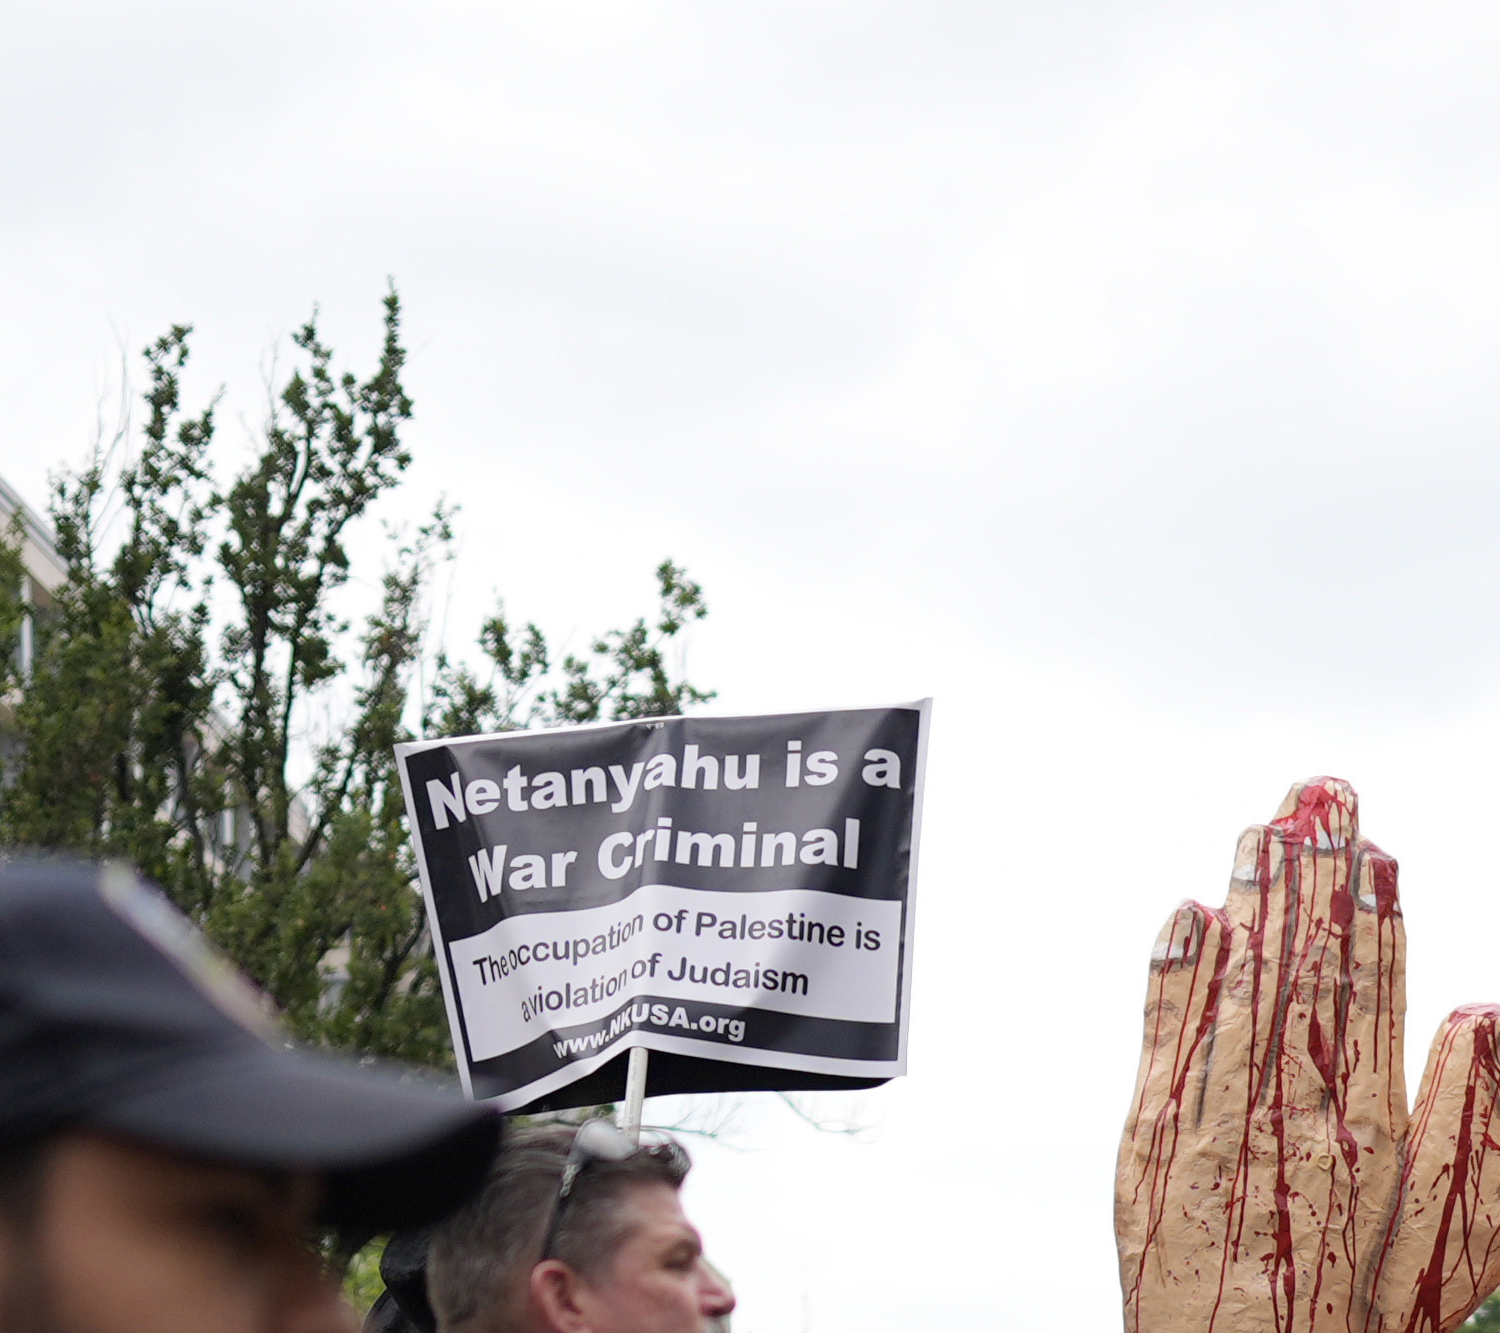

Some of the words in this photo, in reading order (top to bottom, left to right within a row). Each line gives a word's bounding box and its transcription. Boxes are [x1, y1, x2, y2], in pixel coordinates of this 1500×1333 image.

[426, 744, 760, 830] Netanyahu
[785, 740, 838, 788] is
[862, 747, 901, 789] a
[468, 844, 577, 903] War
[598, 817, 860, 879] Criminal
[472, 954, 510, 986] The
[510, 912, 644, 972] occupation
[652, 909, 687, 933] of
[695, 911, 845, 947] Palestine
[854, 921, 882, 951] is
[521, 1000, 530, 1023] a
[529, 969, 627, 1014] violation
[631, 952, 660, 980] of
[667, 956, 809, 996] Judaism
[553, 1001, 746, 1059] www.NKUSA.org
